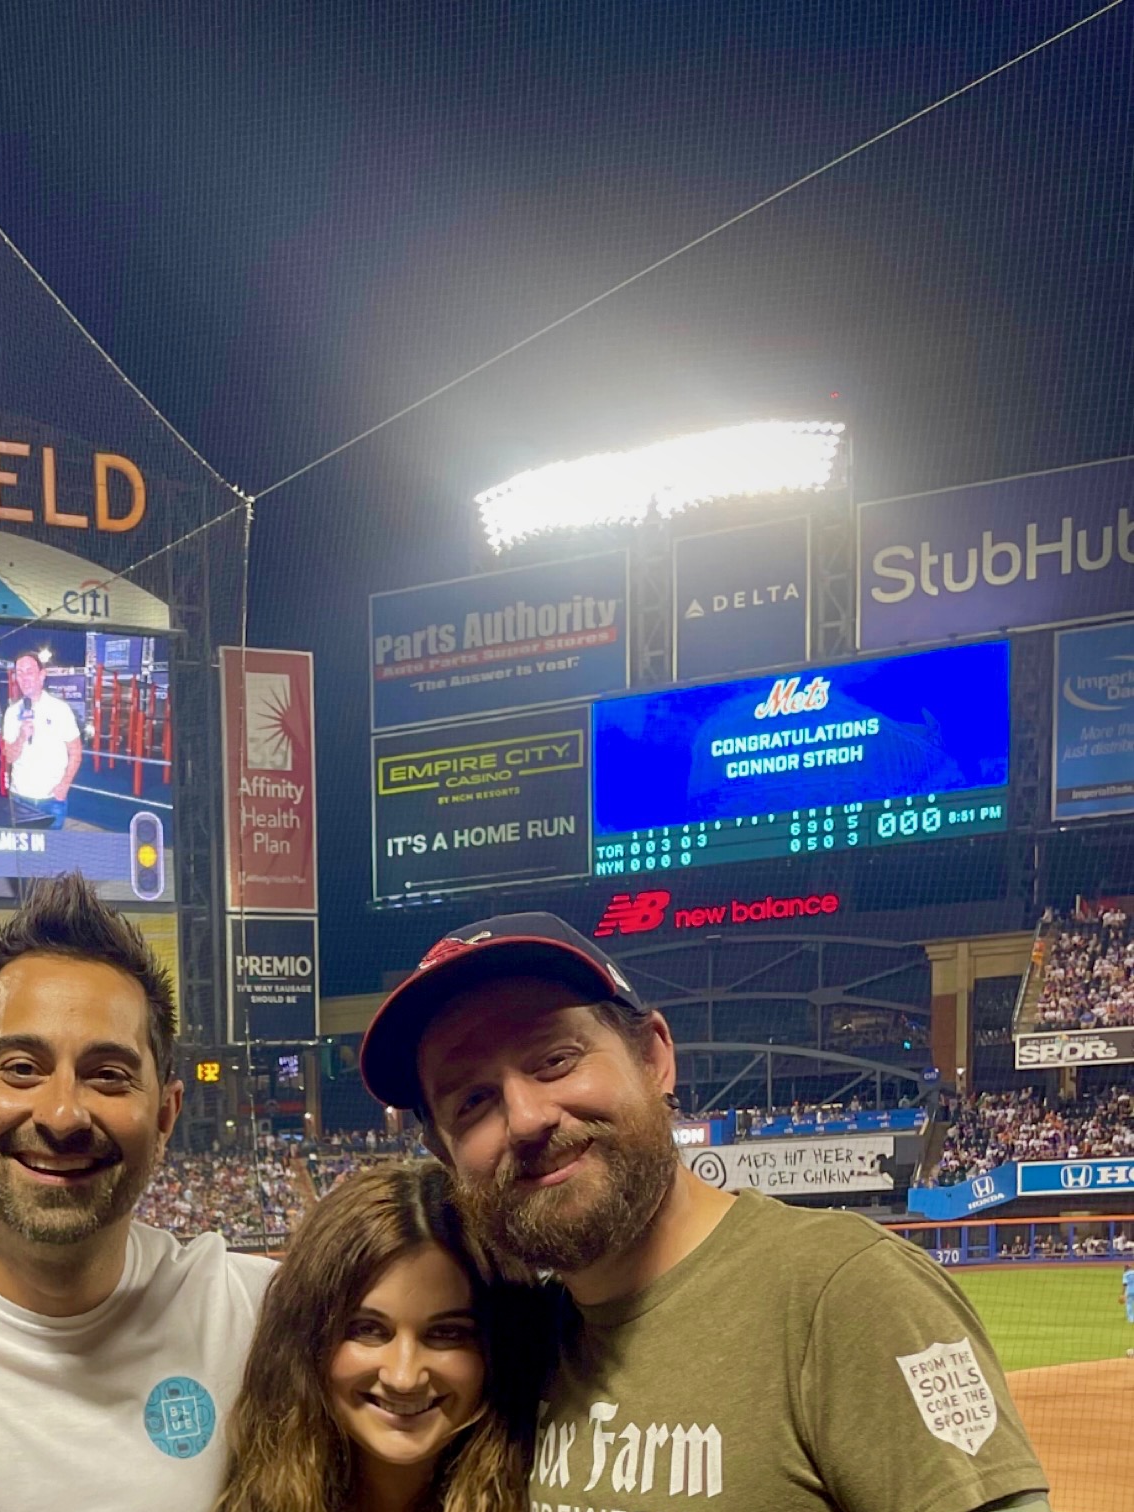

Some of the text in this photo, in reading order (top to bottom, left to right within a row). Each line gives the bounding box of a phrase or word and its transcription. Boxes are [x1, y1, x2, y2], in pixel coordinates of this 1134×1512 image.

[712, 582, 800, 613] DELTA
[374, 594, 616, 665] Parts Authority
[382, 662, 424, 678] Auto
[429, 653, 478, 667] Parts
[544, 631, 610, 649] Stores
[450, 669, 511, 687] Answer
[754, 676, 830, 719] Mets
[711, 718, 879, 757] CONGRATULATIONS
[389, 753, 497, 782] EMPIRE
[726, 745, 863, 778] CONNOR STROH
[240, 776, 304, 804] Affinity
[445, 770, 512, 788] CASINO
[476, 787, 520, 800] RESORTS
[241, 806, 300, 829] Health
[980, 805, 1002, 820] PM
[31, 833, 45, 852] IN
[253, 833, 291, 854] Plan
[387, 815, 575, 857] IT'S A HOME RUN
[596, 815, 859, 859] TOR 0 0 3 0 3 6 9 0 5
[596, 832, 858, 876] NYM 0 0 0 0 0 5 0 3
[674, 905, 726, 930] new
[730, 893, 840, 921] balance
[235, 956, 312, 976] PREMIO
[254, 985, 273, 993] WAY
[737, 1149, 853, 1168] METS HIT HEER
[749, 1174, 760, 1187] U
[767, 1172, 797, 1187] GET
[1097, 1166, 1134, 1184] H
[968, 1192, 1005, 1210] HONDA
[936, 1251, 960, 1264] 370
[909, 1351, 972, 1378] FROM THE
[919, 1367, 981, 1398] SOILS
[963, 1388, 987, 1403] THE
[934, 1405, 991, 1430] SPOILS
[583, 1401, 723, 1498] Farm
